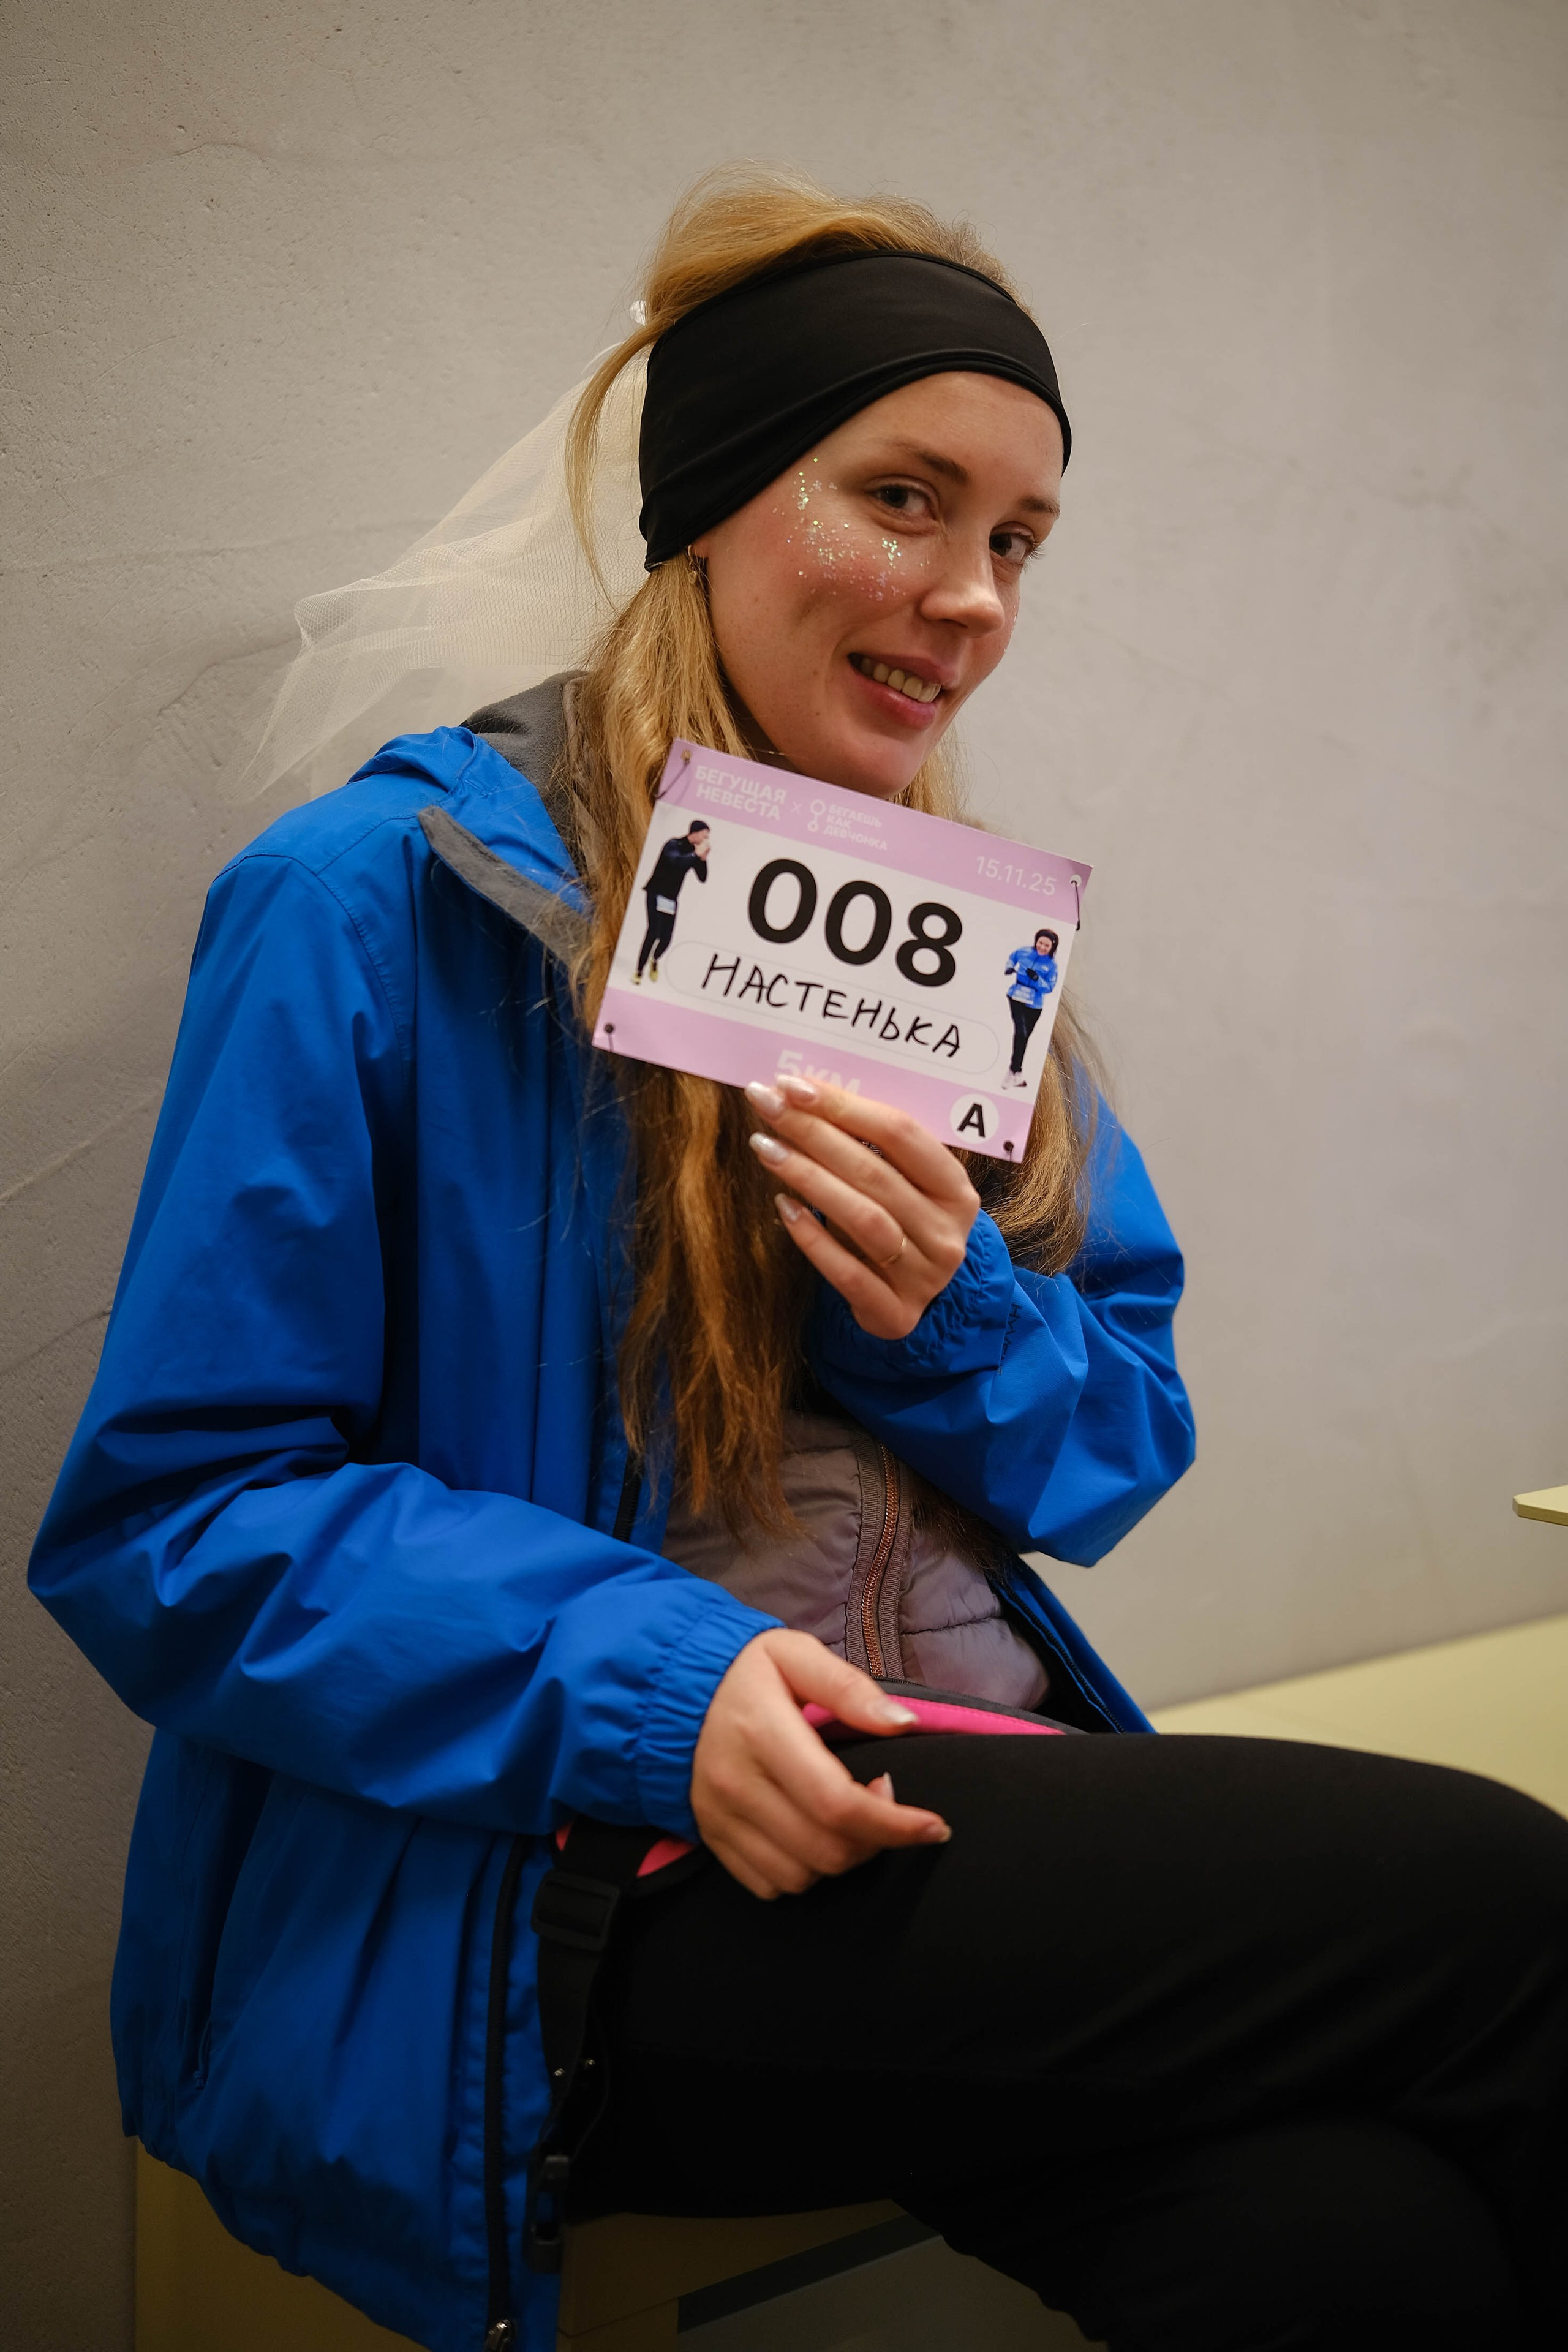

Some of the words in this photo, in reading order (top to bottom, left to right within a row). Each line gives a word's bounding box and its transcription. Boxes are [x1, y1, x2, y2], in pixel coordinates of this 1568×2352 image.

[695, 765, 787, 804] БЕГУЩАЯ
[696, 783, 780, 821] НЕВЕСТА
[826, 813, 852, 830] КАК
[977, 856, 1057, 895] 15.11.25
[747, 858, 963, 987] 008
[701, 953, 960, 1058] НАСТЕНЬКА
[956, 1102, 986, 1139] А
